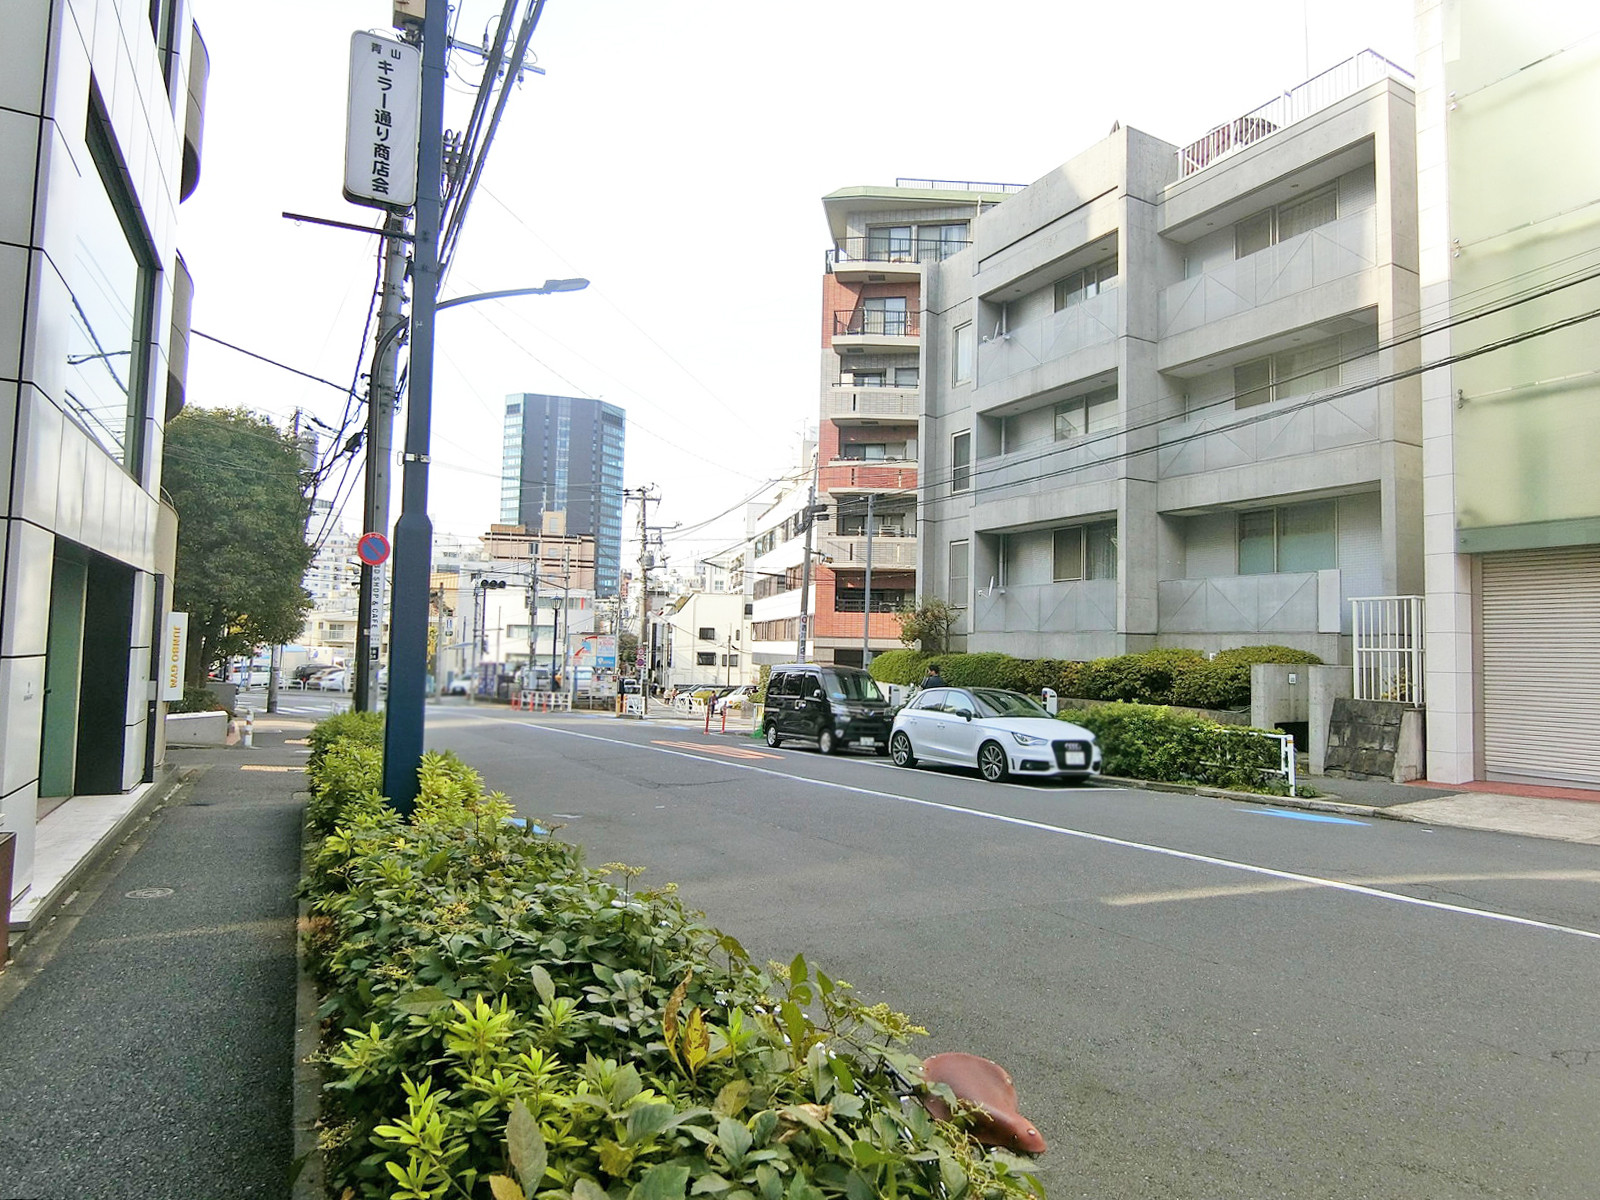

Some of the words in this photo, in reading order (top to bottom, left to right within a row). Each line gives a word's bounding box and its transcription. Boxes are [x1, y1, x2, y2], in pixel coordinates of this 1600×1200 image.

[371, 42, 401, 60] 青山
[372, 60, 394, 195] キラー通り商店会
[372, 577, 380, 599] SHOP
[169, 664, 178, 689] GYM
